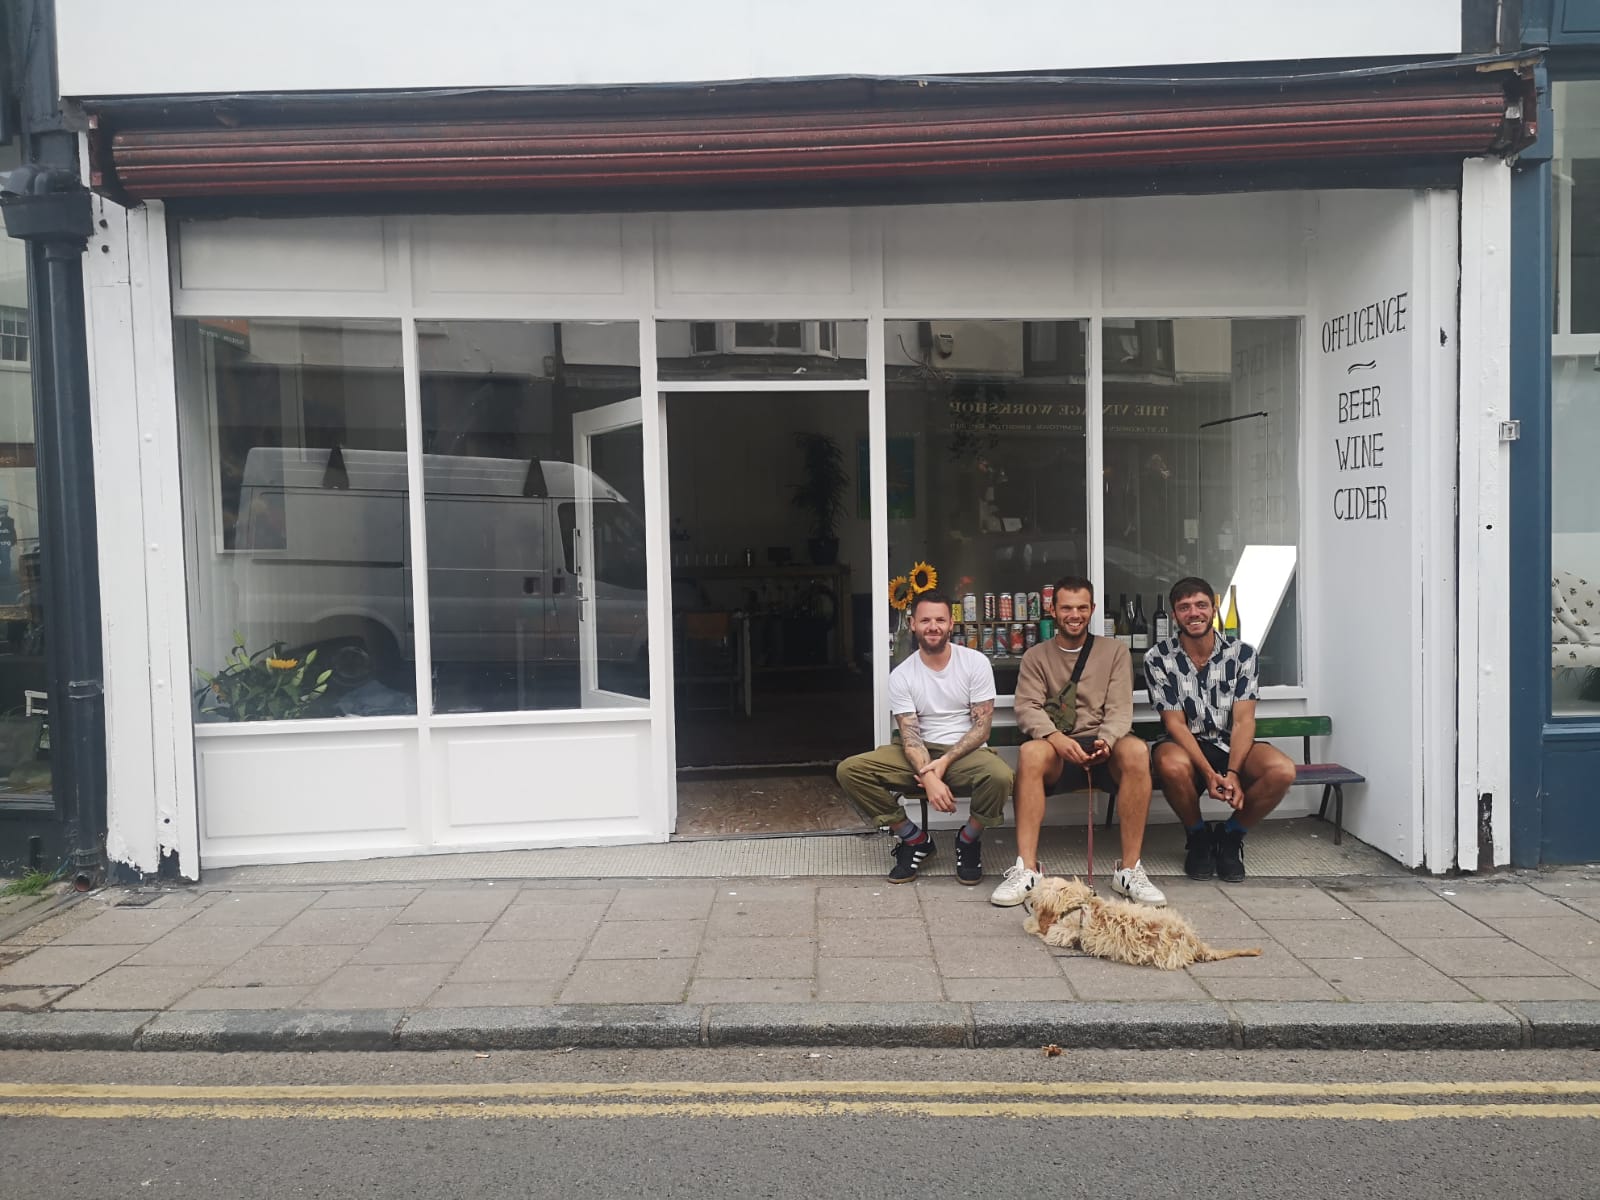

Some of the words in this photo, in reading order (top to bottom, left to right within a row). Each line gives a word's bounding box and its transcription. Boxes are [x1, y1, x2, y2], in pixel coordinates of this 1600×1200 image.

[1338, 386, 1381, 423] BEER
[1335, 432, 1384, 470] WINE
[1334, 486, 1387, 520] CIDER
